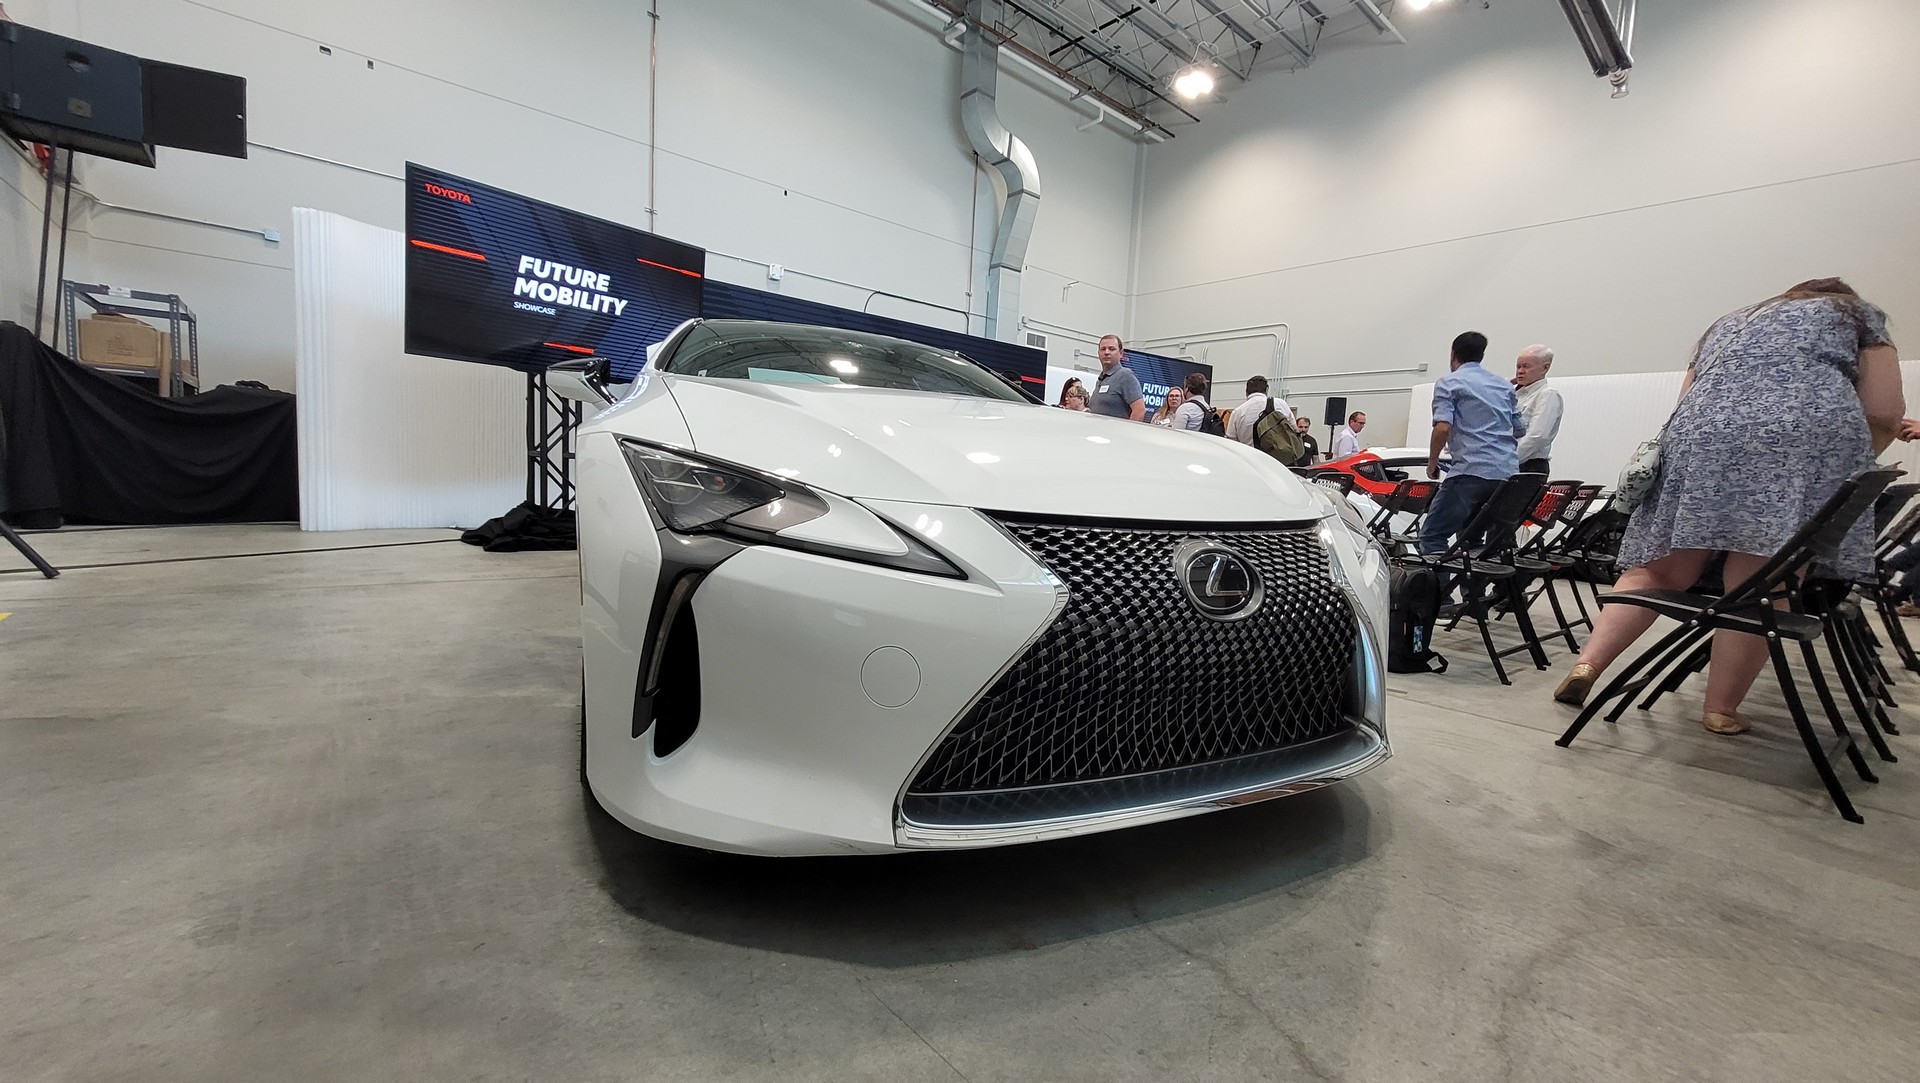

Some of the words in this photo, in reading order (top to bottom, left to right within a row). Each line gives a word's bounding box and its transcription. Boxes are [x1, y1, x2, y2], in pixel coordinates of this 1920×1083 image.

[424, 183, 472, 204] TOYOTA
[518, 255, 611, 292] FUTURE
[513, 277, 628, 316] MOBILITY
[513, 301, 557, 316] SHOWCASE
[1142, 382, 1172, 396] FUTUR
[1142, 394, 1164, 407] MOBI
